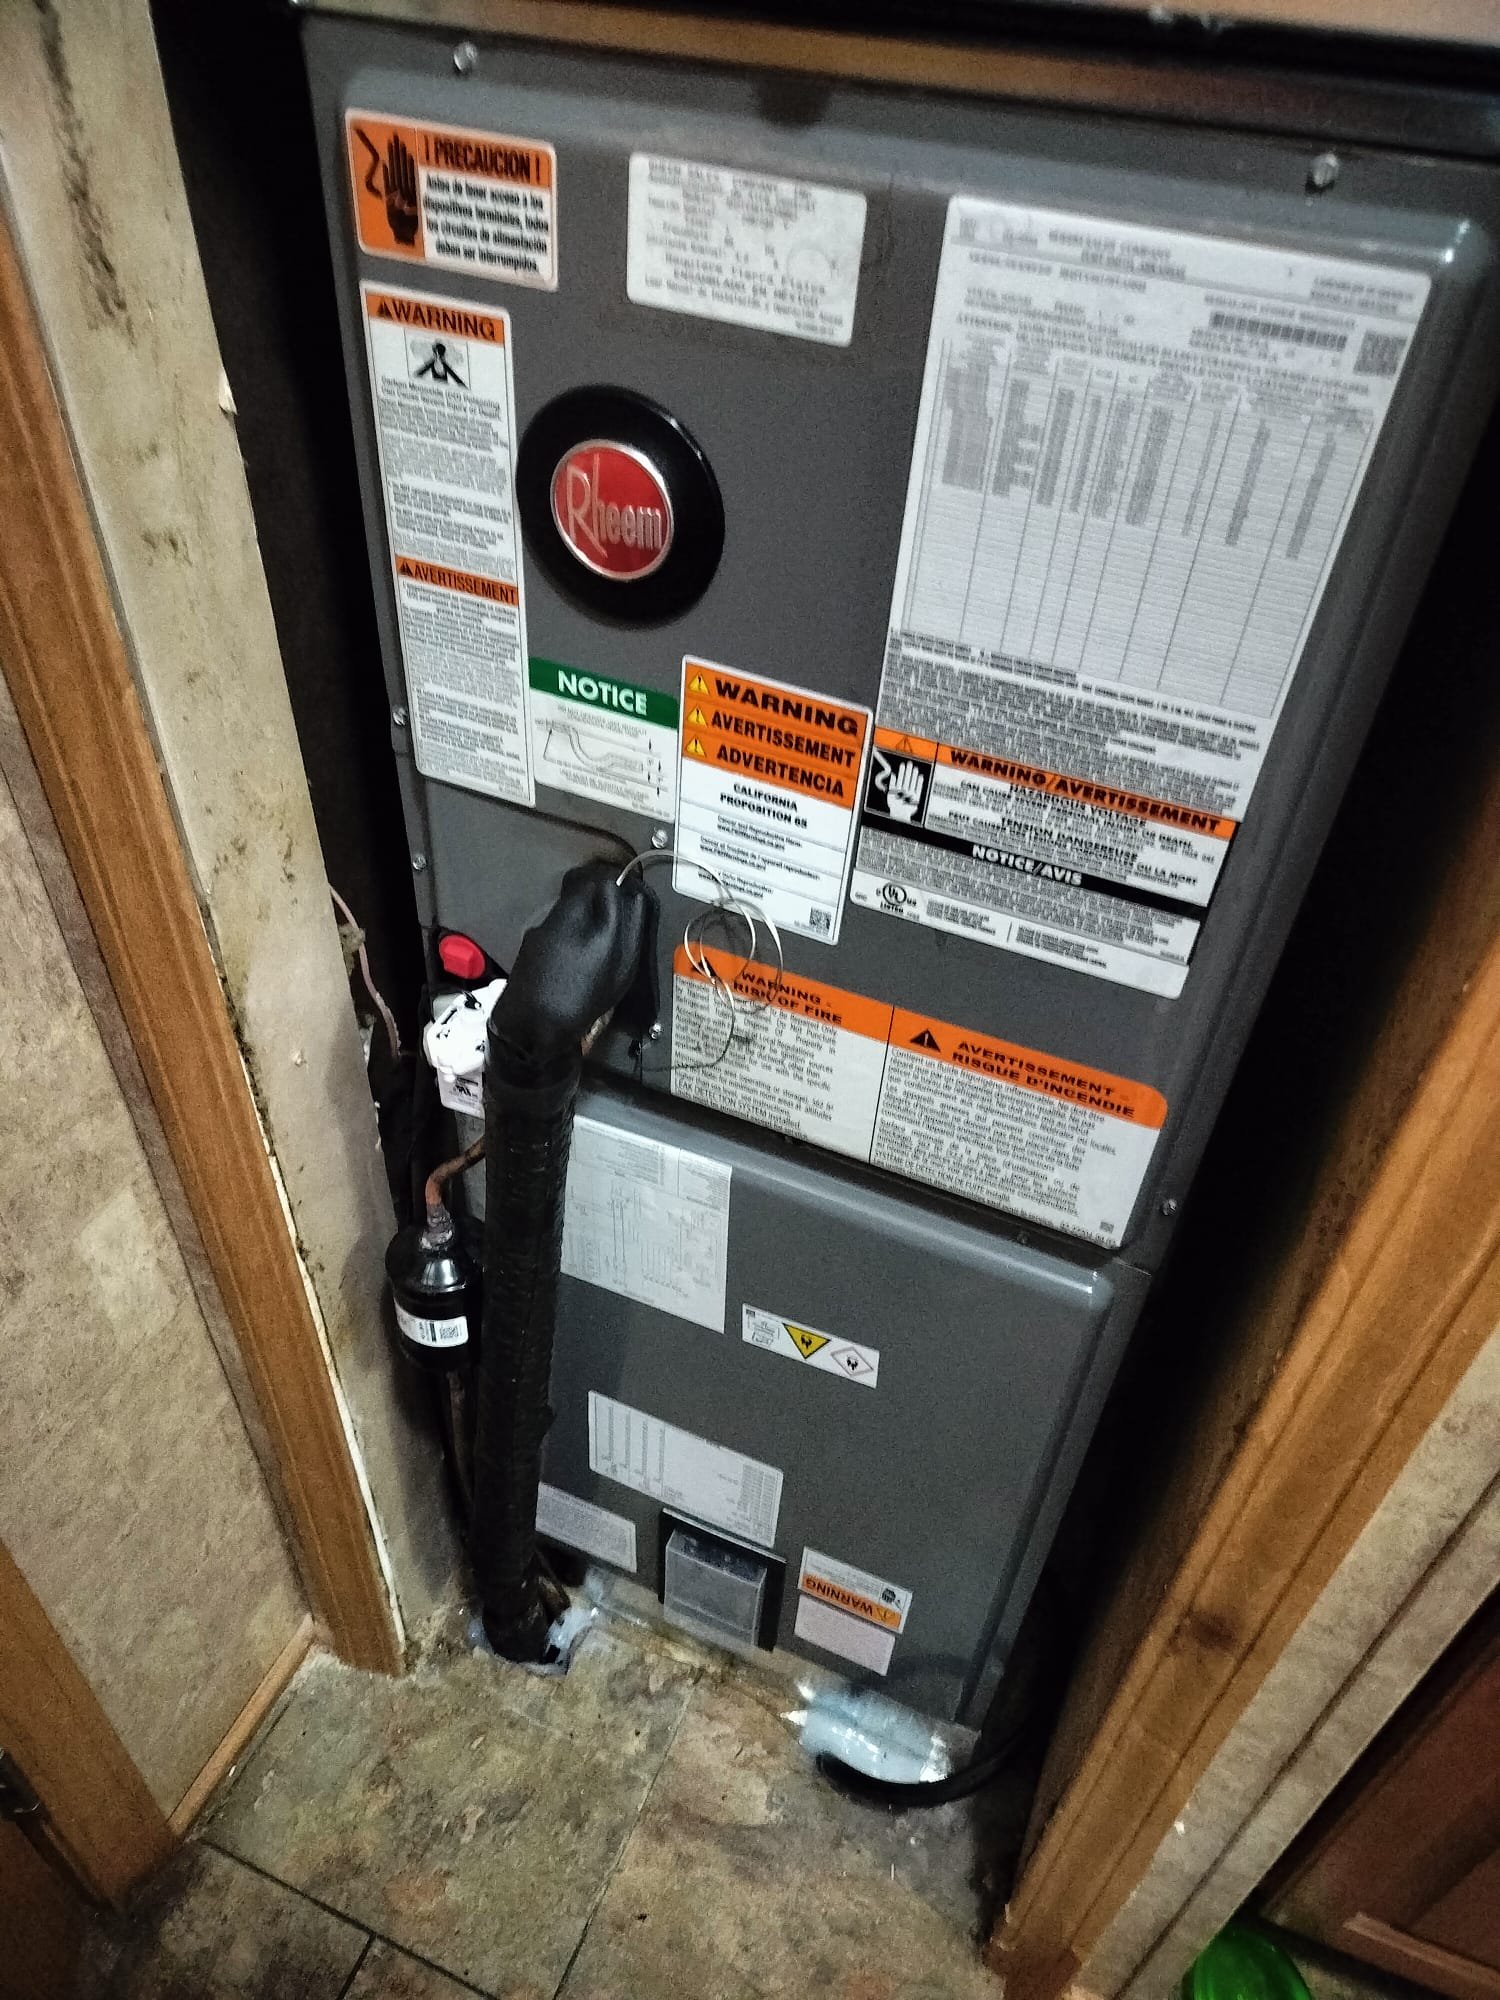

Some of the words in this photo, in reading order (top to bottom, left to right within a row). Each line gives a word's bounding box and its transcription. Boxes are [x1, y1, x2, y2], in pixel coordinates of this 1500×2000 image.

[433, 136, 530, 182] PRECAUCION
[392, 298, 495, 342] WARNING
[566, 453, 662, 555] Rheem
[413, 563, 515, 605] AVERTISSEMENT
[558, 670, 647, 715] NOTICE
[714, 678, 859, 737] WARNING
[711, 710, 855, 768] AVERTISSEMENT
[716, 743, 844, 797] ADVERTENCIA
[949, 749, 1221, 832] WARNING/AVERTISSEMENT
[719, 792, 791, 824] PROPOSITION
[733, 783, 797, 812] CALIFORNIA
[1007, 782, 1087, 812] HAZARDOUS
[1087, 804, 1147, 829] VOLTAGE
[999, 816, 1053, 839] TENSION
[1055, 831, 1138, 862] DANGEREUSE
[971, 843, 1083, 887] NOTICE/AVIS
[742, 971, 821, 1005] WARNING
[777, 995, 798, 1010] OF
[804, 1003, 842, 1025] FIRE
[951, 1051, 1020, 1082] RISQUE
[1025, 1075, 1136, 1118] D'INCENDIE
[957, 1040, 1115, 1098] AVERTISSEMENT
[694, 1084, 735, 1107] DETECTION
[737, 1100, 766, 1117] SYSTEM
[805, 1577, 874, 1617] WARNING
